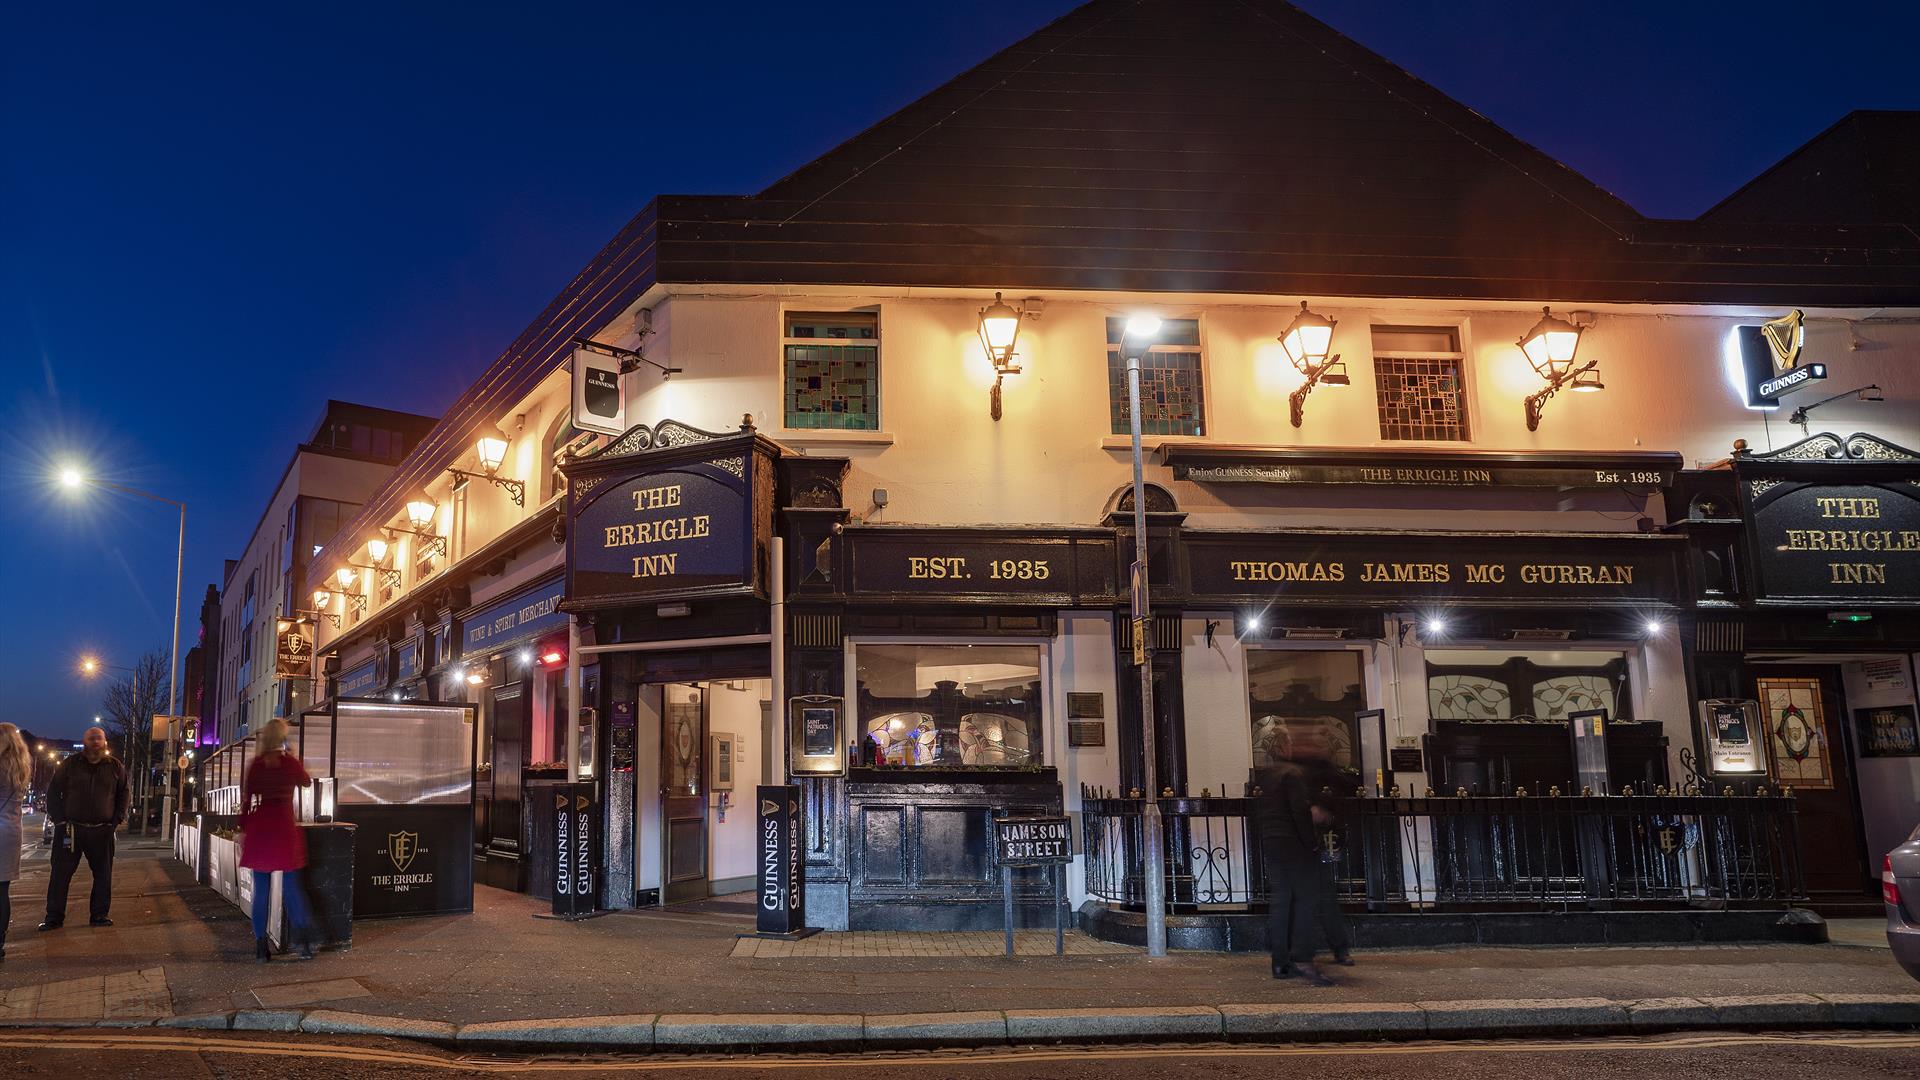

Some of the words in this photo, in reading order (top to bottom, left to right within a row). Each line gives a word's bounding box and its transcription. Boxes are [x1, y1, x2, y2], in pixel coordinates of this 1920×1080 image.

[588, 379, 615, 389] GUINNESS
[1760, 369, 1808, 396] GUINNESS
[1189, 467, 1214, 478] Enjoy
[1215, 467, 1253, 477] GUINNESS
[1255, 469, 1291, 480] Sensibly
[1360, 468, 1392, 480] THE
[1396, 469, 1458, 481] ERRIGLE
[1463, 470, 1490, 482] INN
[1630, 472, 1661, 483] 1935
[632, 485, 681, 511] THE
[1817, 497, 1880, 518] THE
[604, 515, 710, 548] ERRIGLE
[1786, 529, 1920, 551] ERRIGLE
[632, 553, 678, 578] INN
[908, 557, 971, 579] EST.
[990, 560, 1050, 580] 1935
[1231, 561, 1345, 582] THOMAS
[1360, 563, 1450, 583] JAMES
[1465, 564, 1506, 583] MC
[1520, 565, 1634, 584] GURRAN
[1828, 563, 1886, 584] INN
[469, 625, 486, 643] WINE
[488, 624, 493, 637] &
[495, 613, 516, 634] SPIRIT
[1002, 824, 1065, 842] JAMESON
[556, 811, 568, 895] GUINNESS
[577, 813, 589, 895] GUINNESS
[1007, 841, 1062, 858] STREET
[763, 819, 778, 911] GUINNESS
[789, 819, 798, 910] GUINNESS
[371, 875, 392, 886] THE
[393, 873, 433, 885] ERRIGLE
